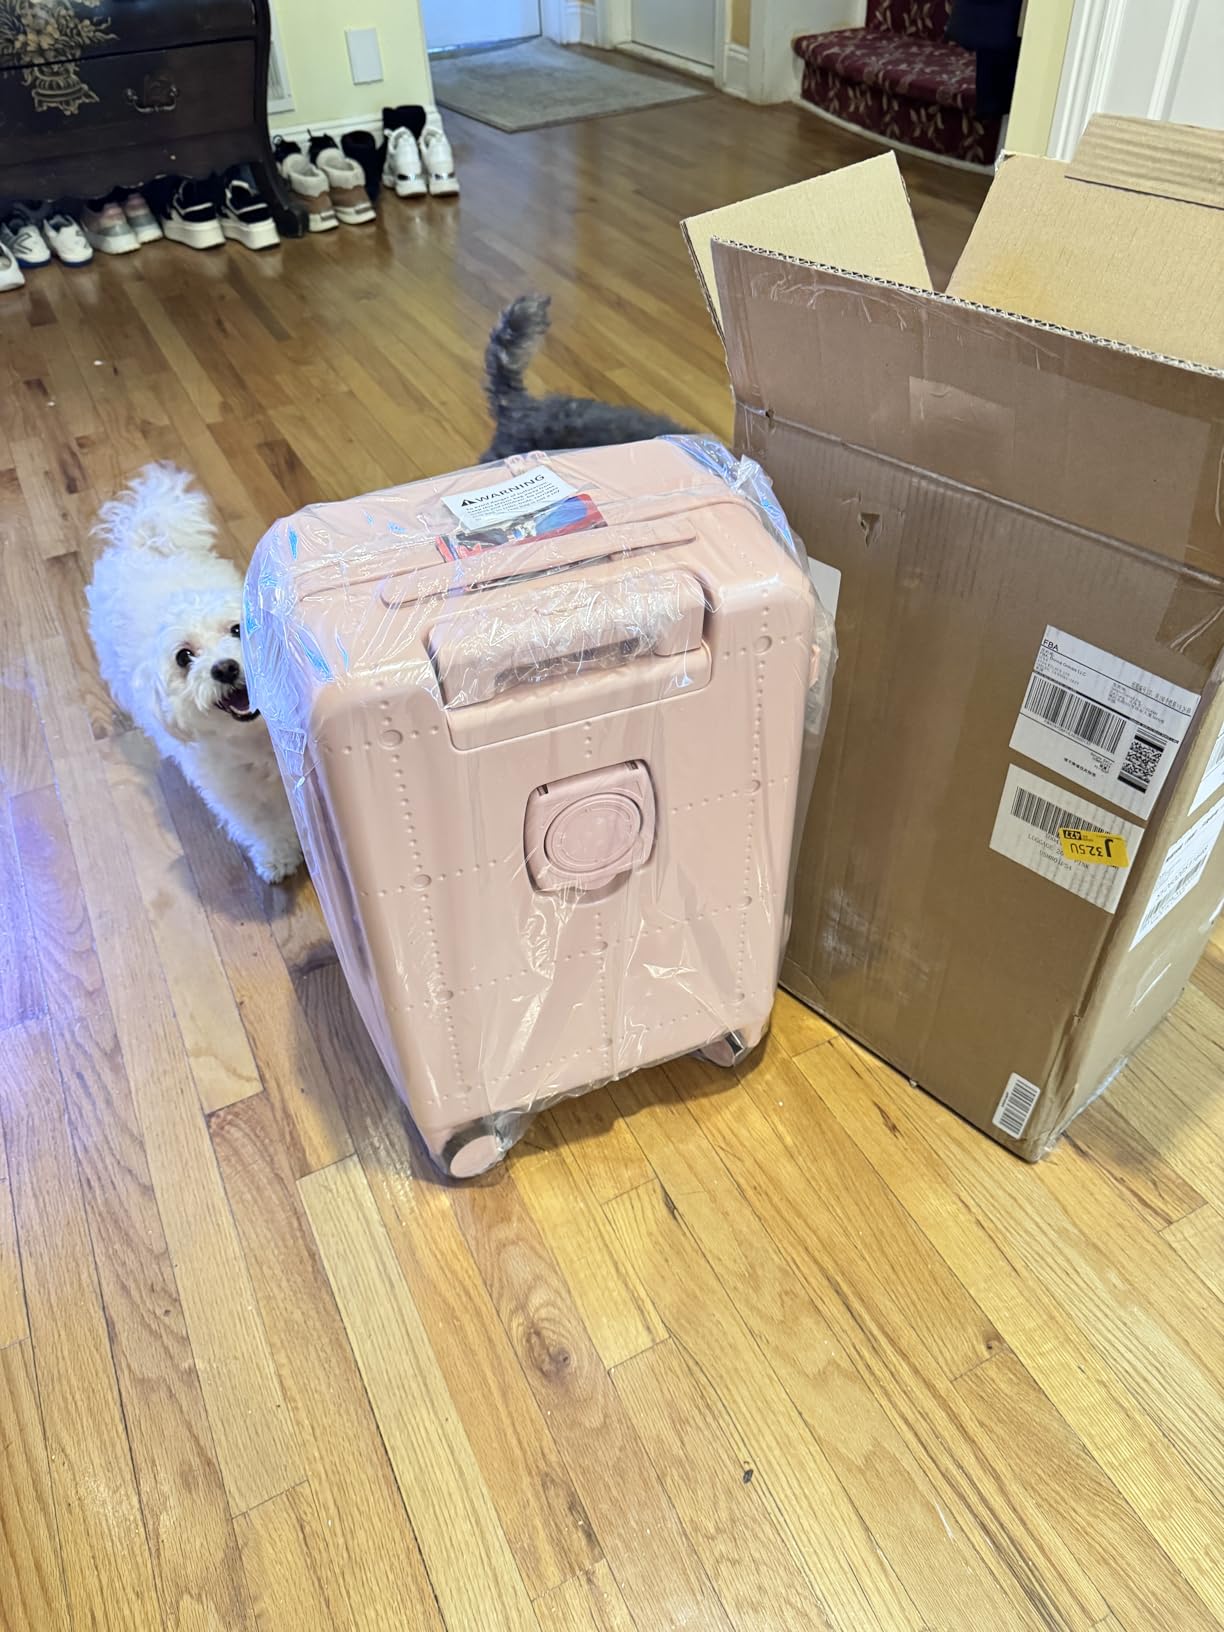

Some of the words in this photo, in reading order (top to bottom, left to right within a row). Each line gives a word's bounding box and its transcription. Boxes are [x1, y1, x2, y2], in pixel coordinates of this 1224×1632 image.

[475, 474, 545, 502] WARNING
[1043, 638, 1059, 652] FBA
[1104, 838, 1114, 858] J
